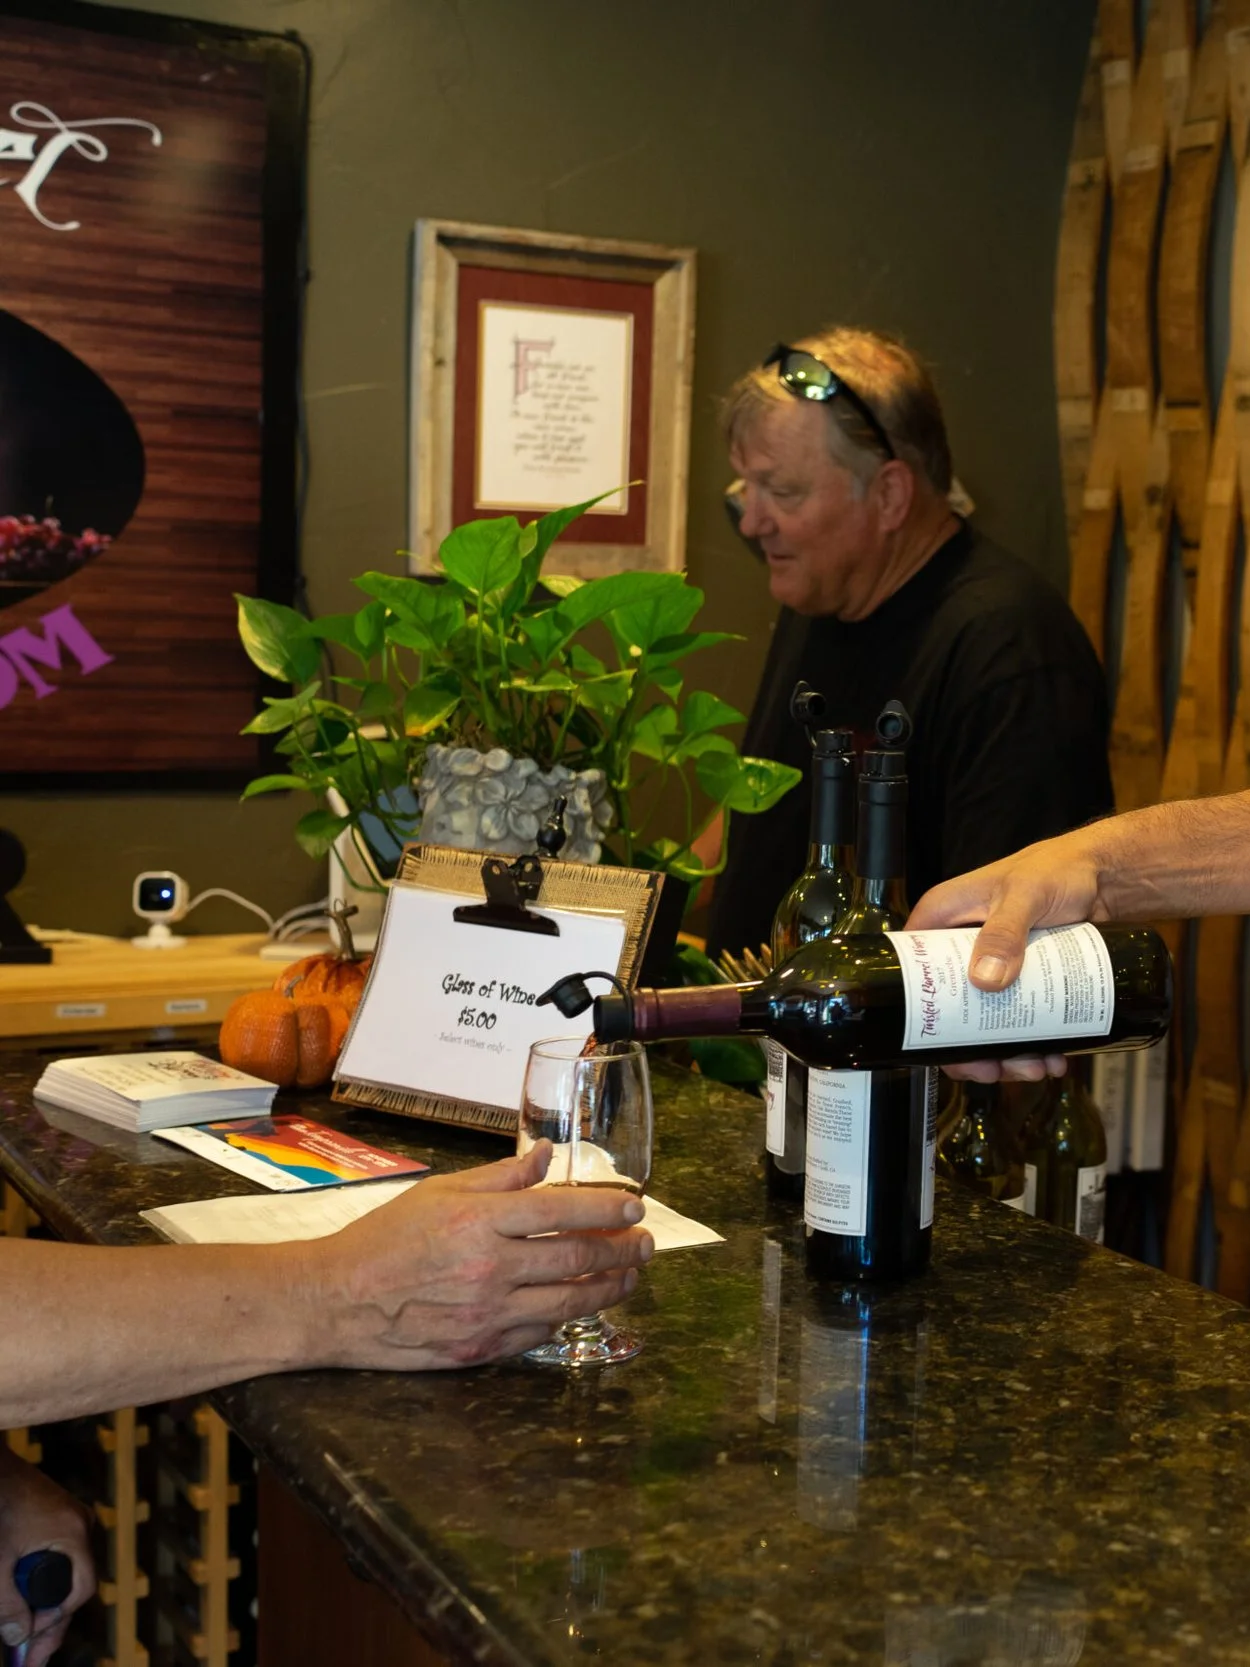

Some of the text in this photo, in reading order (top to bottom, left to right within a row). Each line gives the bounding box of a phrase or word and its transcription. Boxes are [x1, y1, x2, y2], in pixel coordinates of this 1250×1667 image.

[441, 973, 536, 1006] Glass of Wine
[914, 960, 937, 998] Barrel
[936, 966, 946, 985] 2017
[944, 954, 958, 997] Grenache
[457, 1005, 497, 1030] $5.00
[919, 1000, 940, 1038] Twisted
